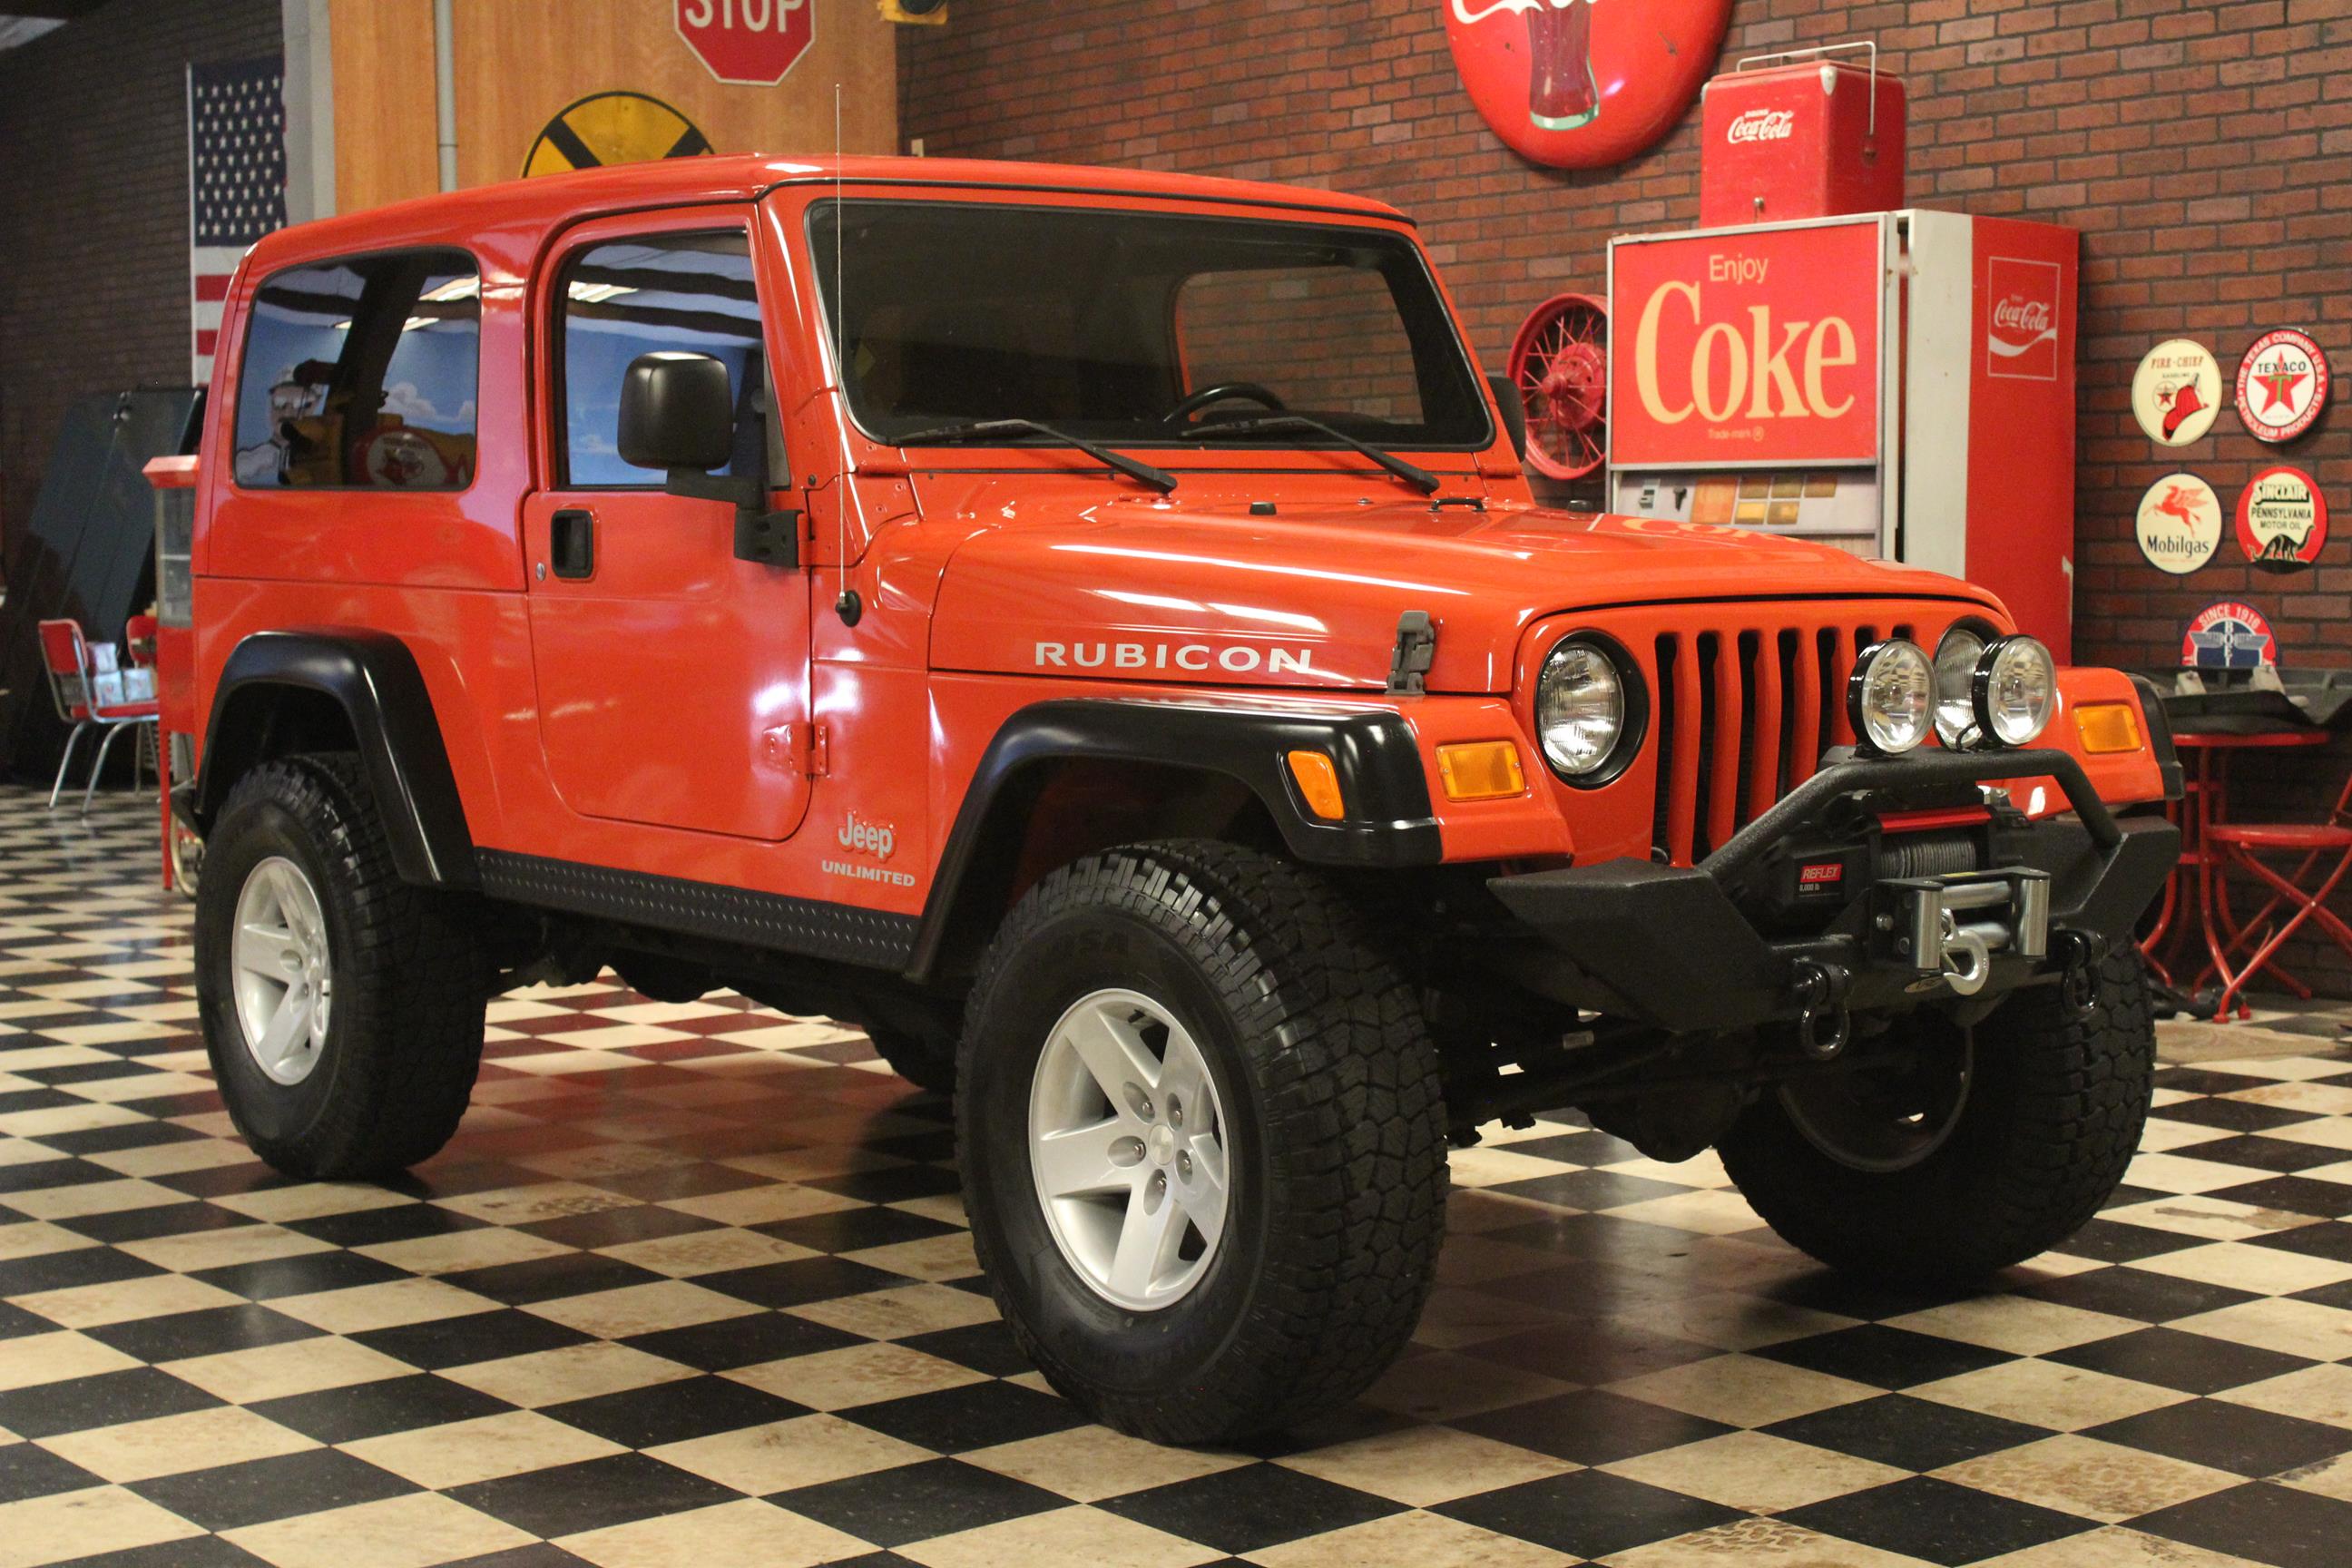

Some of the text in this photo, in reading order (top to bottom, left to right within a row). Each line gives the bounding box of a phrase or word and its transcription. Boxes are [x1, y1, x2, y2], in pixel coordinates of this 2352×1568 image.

[685, 0, 802, 33] STOP
[1710, 253, 1769, 285] Enjoy
[1636, 280, 1857, 425] Coke
[2272, 332, 2317, 355] COMPANY
[2258, 361, 2307, 373] TEXACO
[2251, 508, 2311, 519] PENNSYLVANIA
[2260, 521, 2301, 530] MOTOR OIL
[2147, 534, 2210, 558] Mobilgas
[2198, 603, 2230, 627] SINCE
[1035, 642, 1311, 673] RUBICON
[838, 812, 893, 858] Jeep
[821, 859, 916, 887] UNLIMITED
